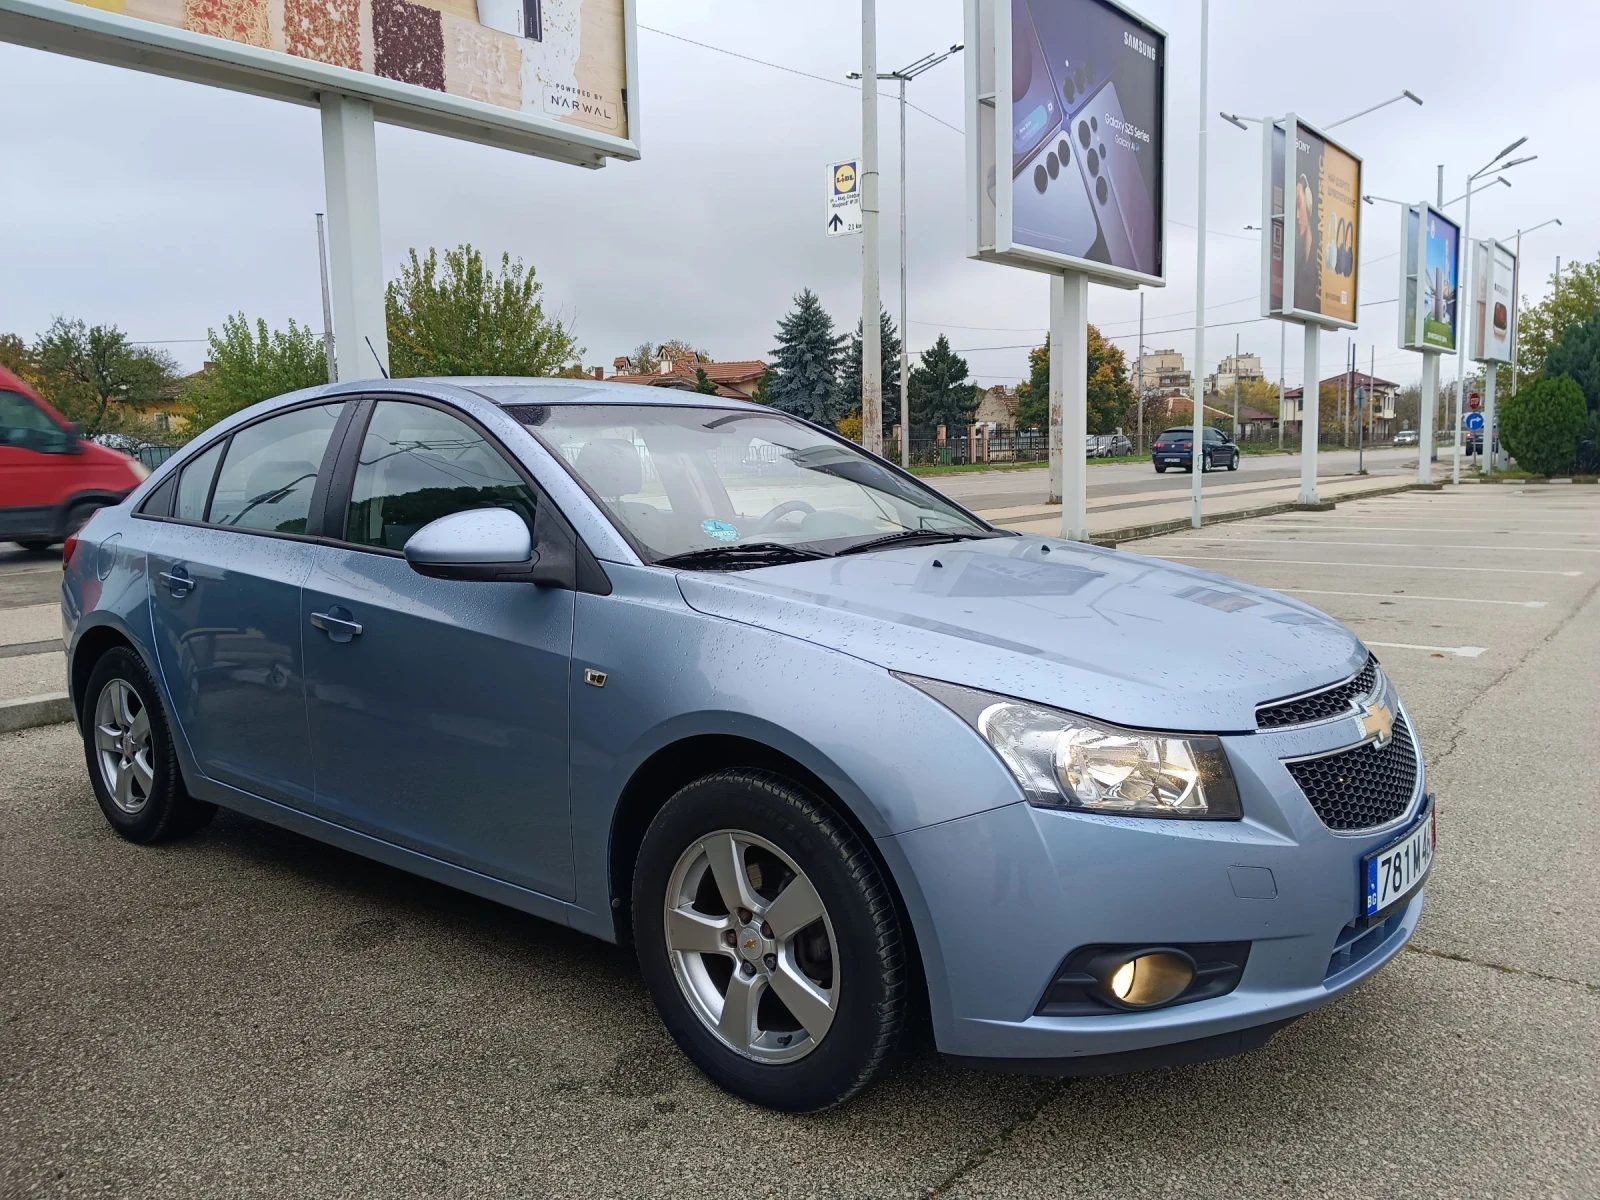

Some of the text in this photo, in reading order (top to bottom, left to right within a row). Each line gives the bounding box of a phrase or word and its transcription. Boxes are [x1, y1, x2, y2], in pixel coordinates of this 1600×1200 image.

[1124, 31, 1156, 61] SAMSUNG
[555, 83, 603, 101] POWERED BY
[551, 95, 612, 119] NARWAL
[1104, 113, 1150, 143] Galaxy S25 Series
[1114, 134, 1131, 151] Galaxy
[1296, 138, 1311, 154] SONY
[1367, 893, 1377, 909] BG
